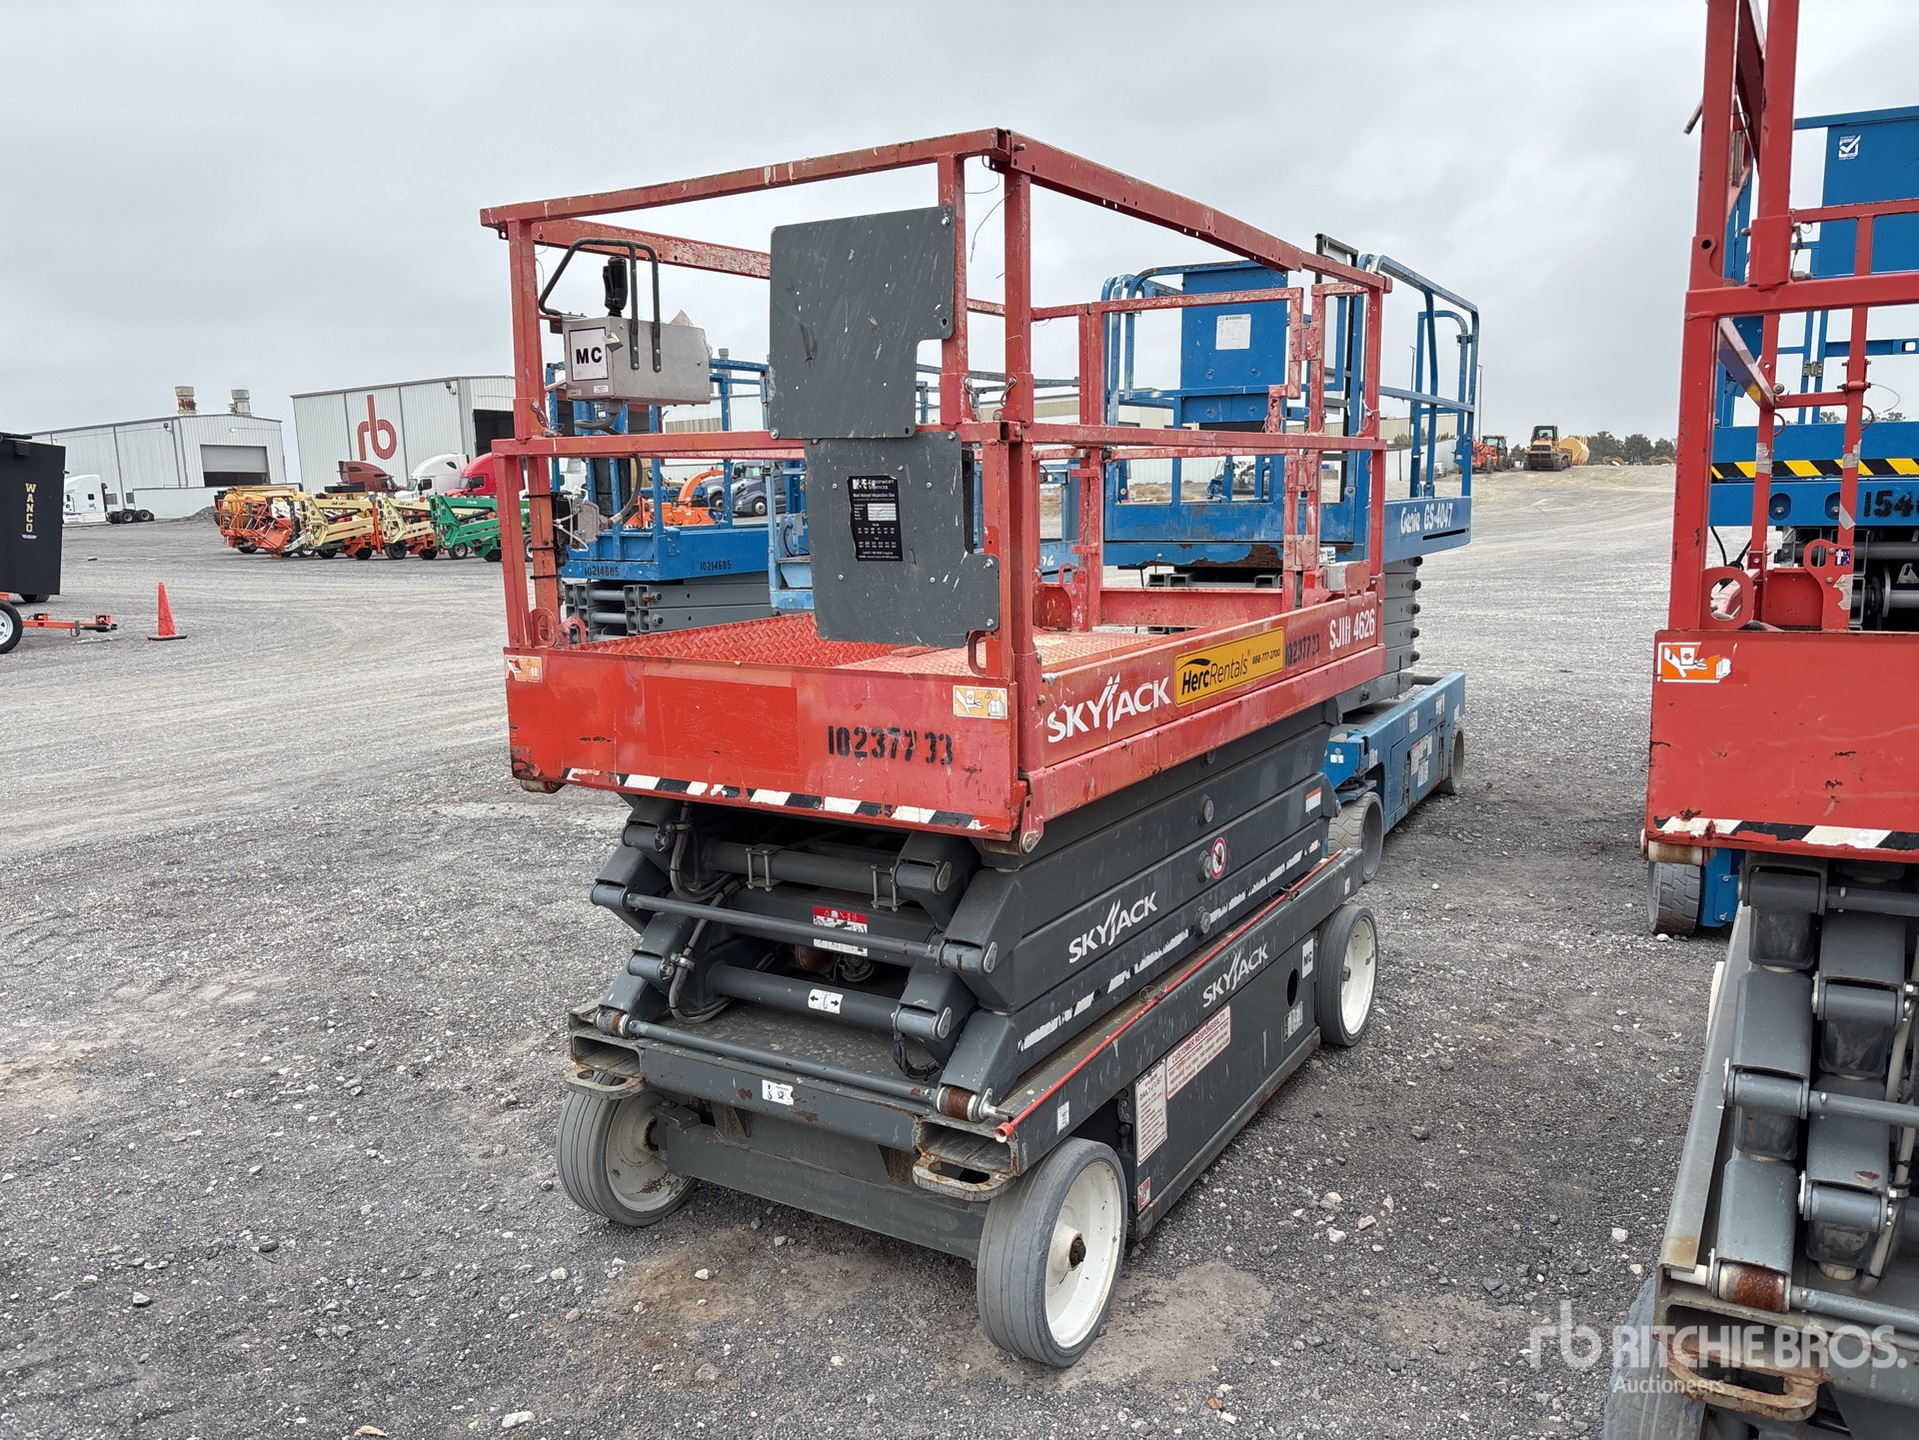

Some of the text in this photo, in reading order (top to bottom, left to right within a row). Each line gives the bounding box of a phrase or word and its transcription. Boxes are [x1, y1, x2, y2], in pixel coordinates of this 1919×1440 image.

[575, 347, 603, 365] MC
[357, 394, 398, 461] rb
[24, 482, 37, 533] WANCO
[1400, 502, 1454, 535] Genie GS-4047
[1863, 490, 1919, 517] 154
[1353, 608, 1376, 641] 4626
[1047, 672, 1172, 744] SKYJACK
[1068, 890, 1158, 964] SKYJACK
[1202, 940, 1269, 1008] SKYJACK
